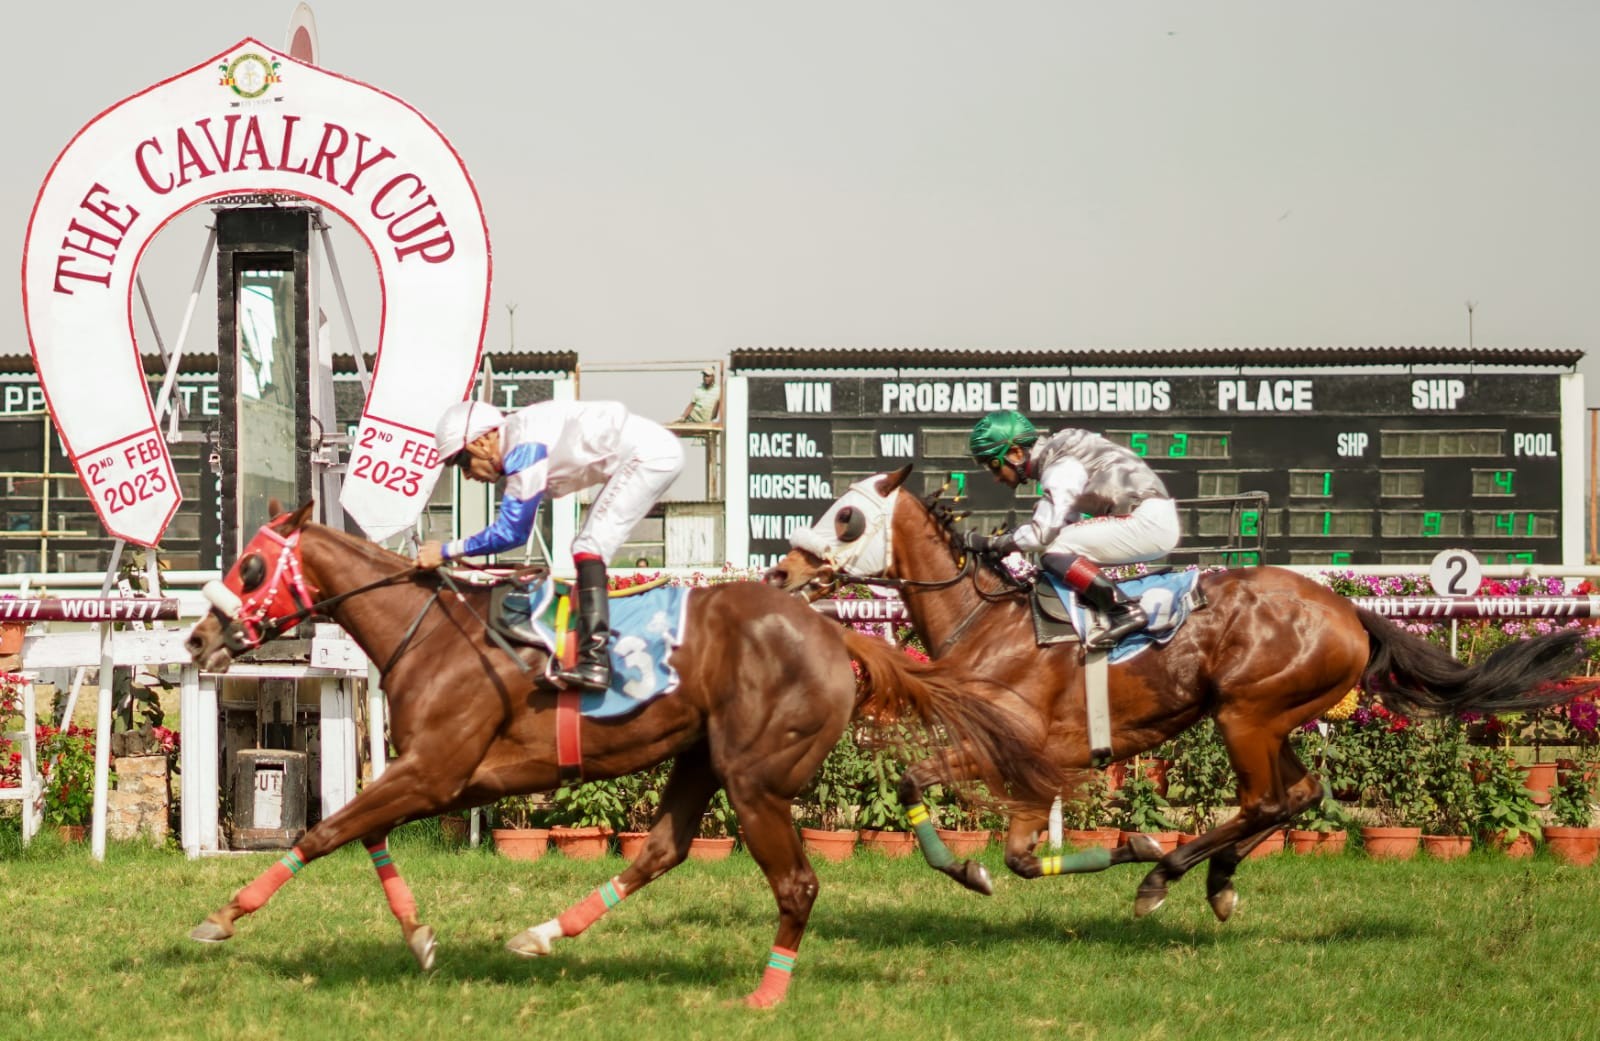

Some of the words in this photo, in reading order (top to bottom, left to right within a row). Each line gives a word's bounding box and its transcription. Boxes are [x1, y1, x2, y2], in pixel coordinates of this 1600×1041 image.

[54, 183, 141, 295] THE
[134, 113, 397, 196] CAVALRY
[370, 172, 455, 264] CUP
[784, 382, 832, 413] WIN
[882, 382, 1019, 413] PROBABLE
[1029, 381, 1171, 412] DIVIDENDS
[1218, 380, 1313, 411] PLACE
[1412, 380, 1465, 410] SHP
[359, 427, 394, 450] 2ND
[399, 439, 441, 470] FEB
[749, 433, 793, 458] RACE
[880, 434, 914, 457] WIN
[1337, 433, 1369, 458] SHP
[1514, 433, 1557, 458] POOL
[87, 456, 114, 486] 2ND
[124, 438, 162, 470] FEB
[353, 455, 424, 498] 2023
[749, 474, 807, 499] HORSE
[103, 466, 167, 515] 2023
[750, 514, 783, 541] WIN
[1446, 555, 1468, 595] 2
[0, 599, 42, 619] 777
[61, 599, 162, 619] WOLF777
[1352, 597, 1455, 618] WOLF777
[1474, 597, 1579, 617] WOLF777
[614, 635, 657, 700] 3
